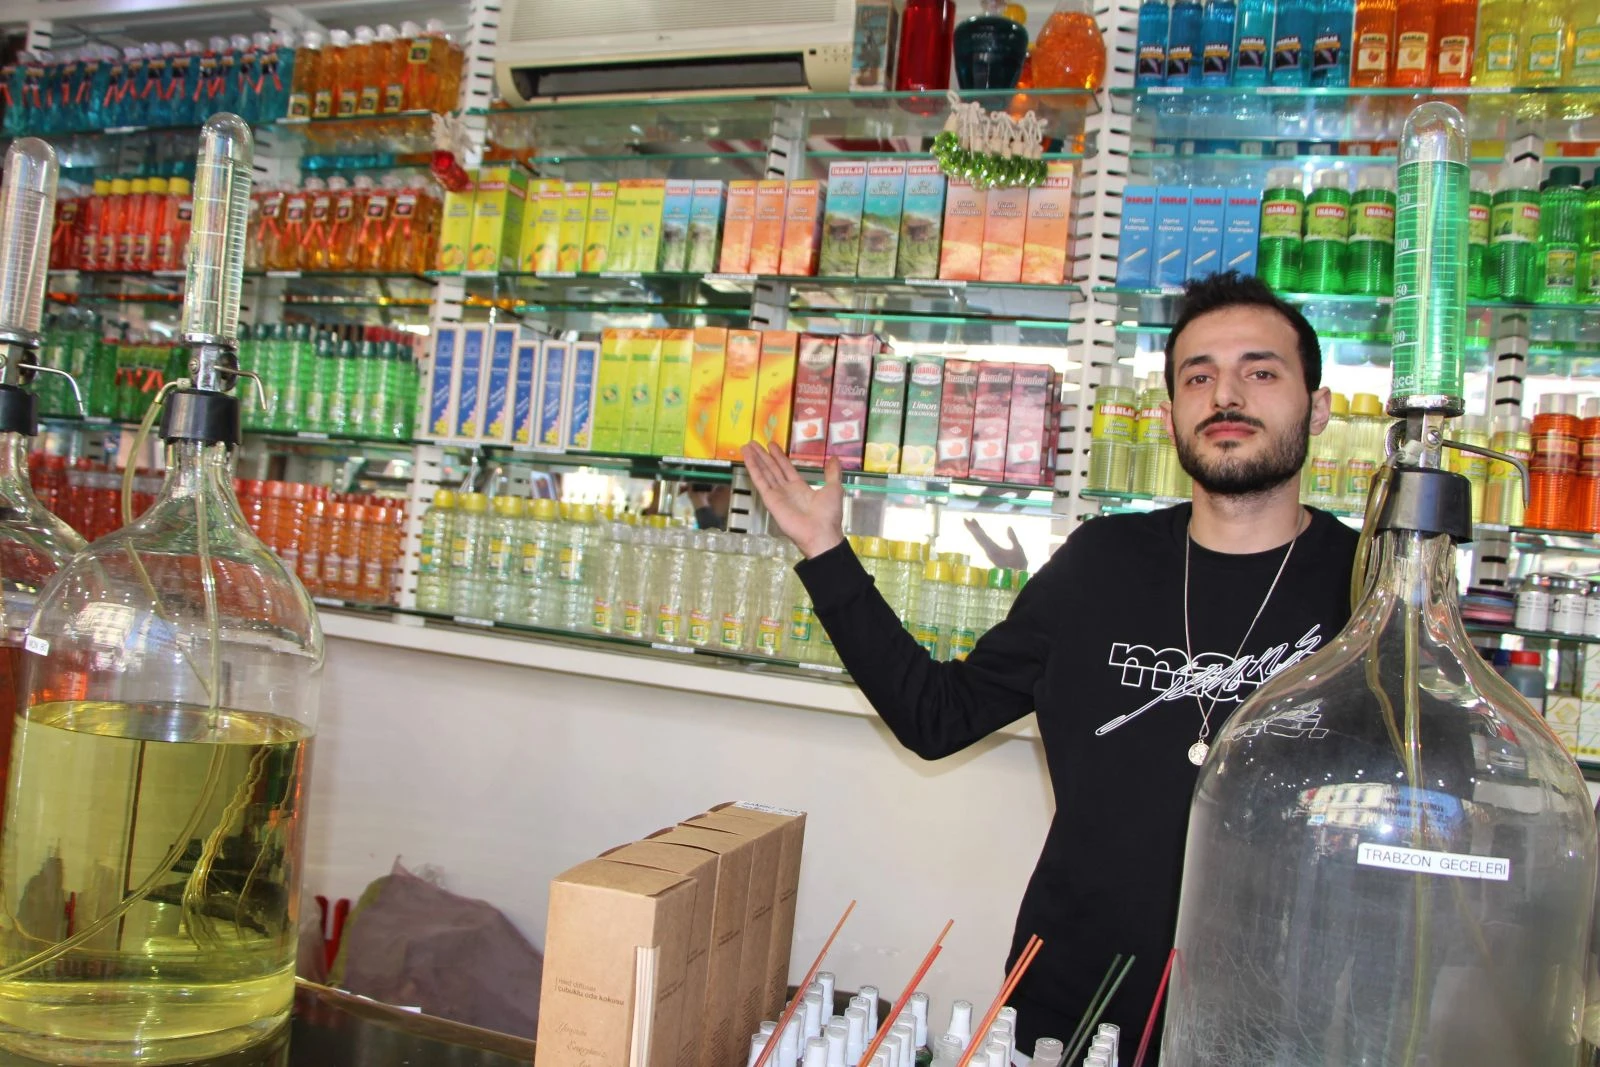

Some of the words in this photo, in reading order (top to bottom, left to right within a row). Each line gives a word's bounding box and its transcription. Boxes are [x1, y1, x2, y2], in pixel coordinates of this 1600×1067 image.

[876, 398, 900, 407] Limon
[912, 401, 937, 410] Limon
[1364, 848, 1431, 867] TRABZON
[1440, 858, 1506, 875] GECELERI
